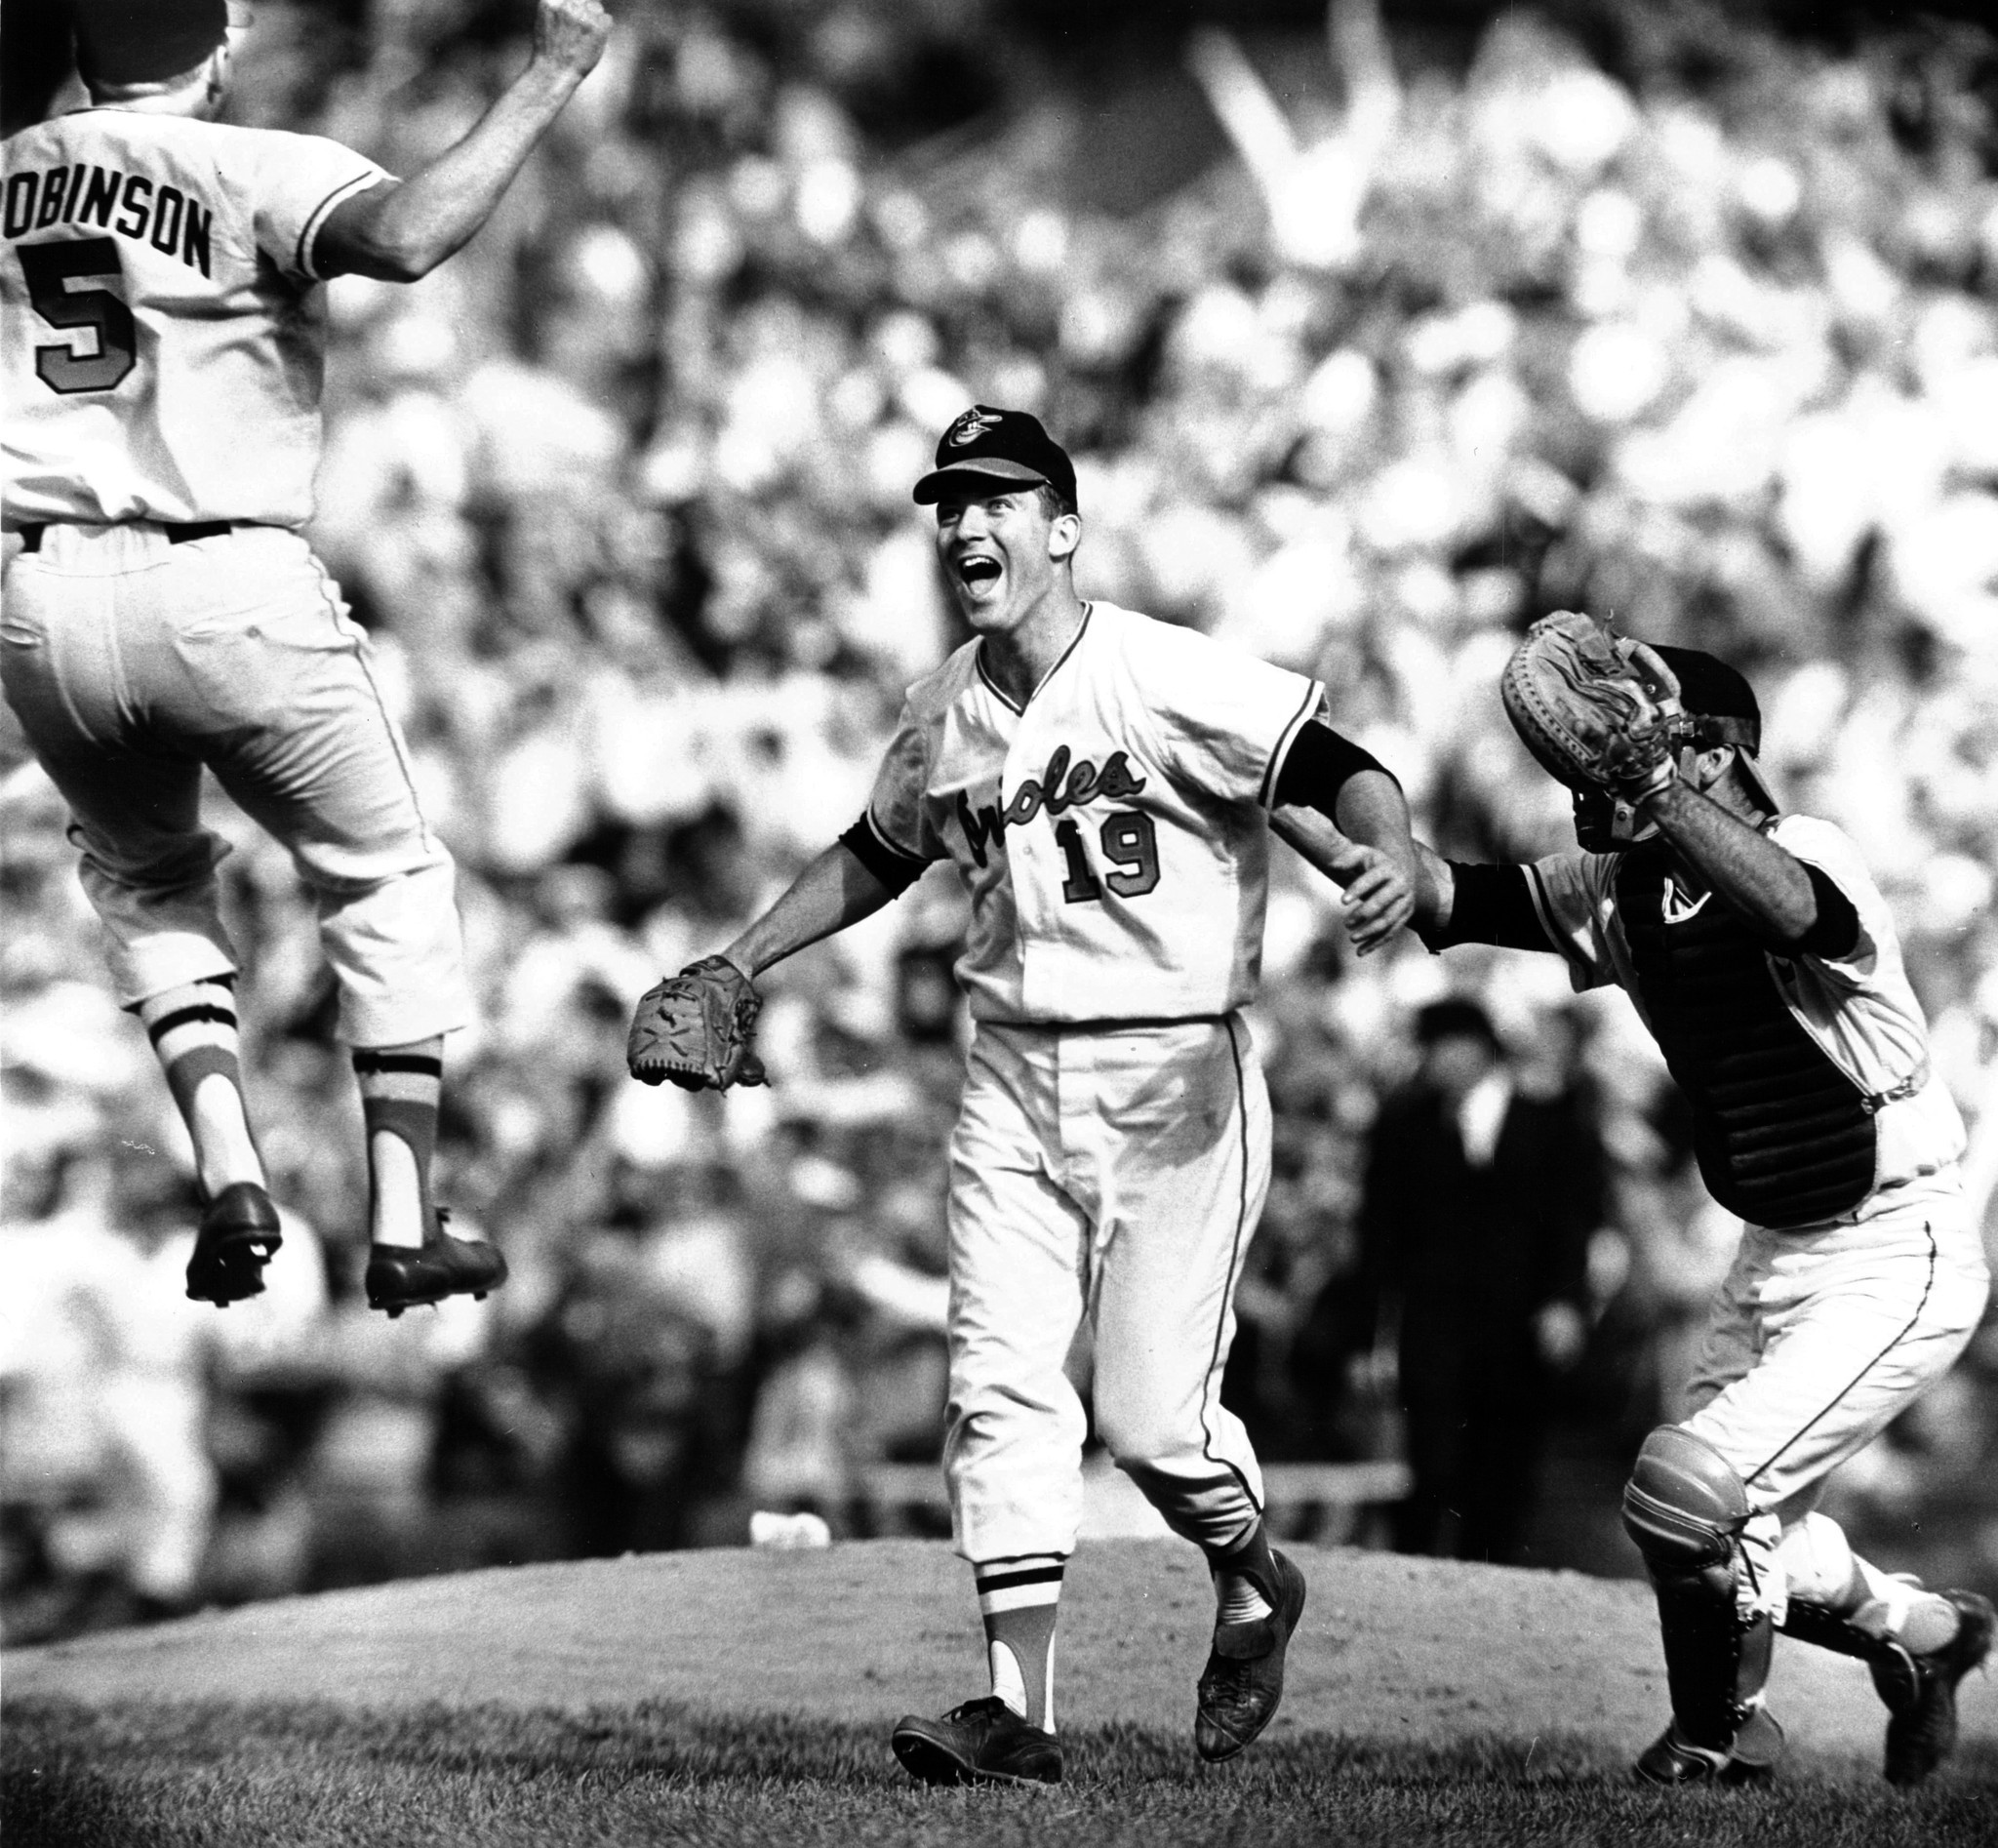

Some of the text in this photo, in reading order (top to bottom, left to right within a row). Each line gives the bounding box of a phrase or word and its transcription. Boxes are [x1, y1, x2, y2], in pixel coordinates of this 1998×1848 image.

[0, 164, 213, 280] OBINSON
[16, 236, 137, 395] 5
[1056, 811, 1161, 904] 19
